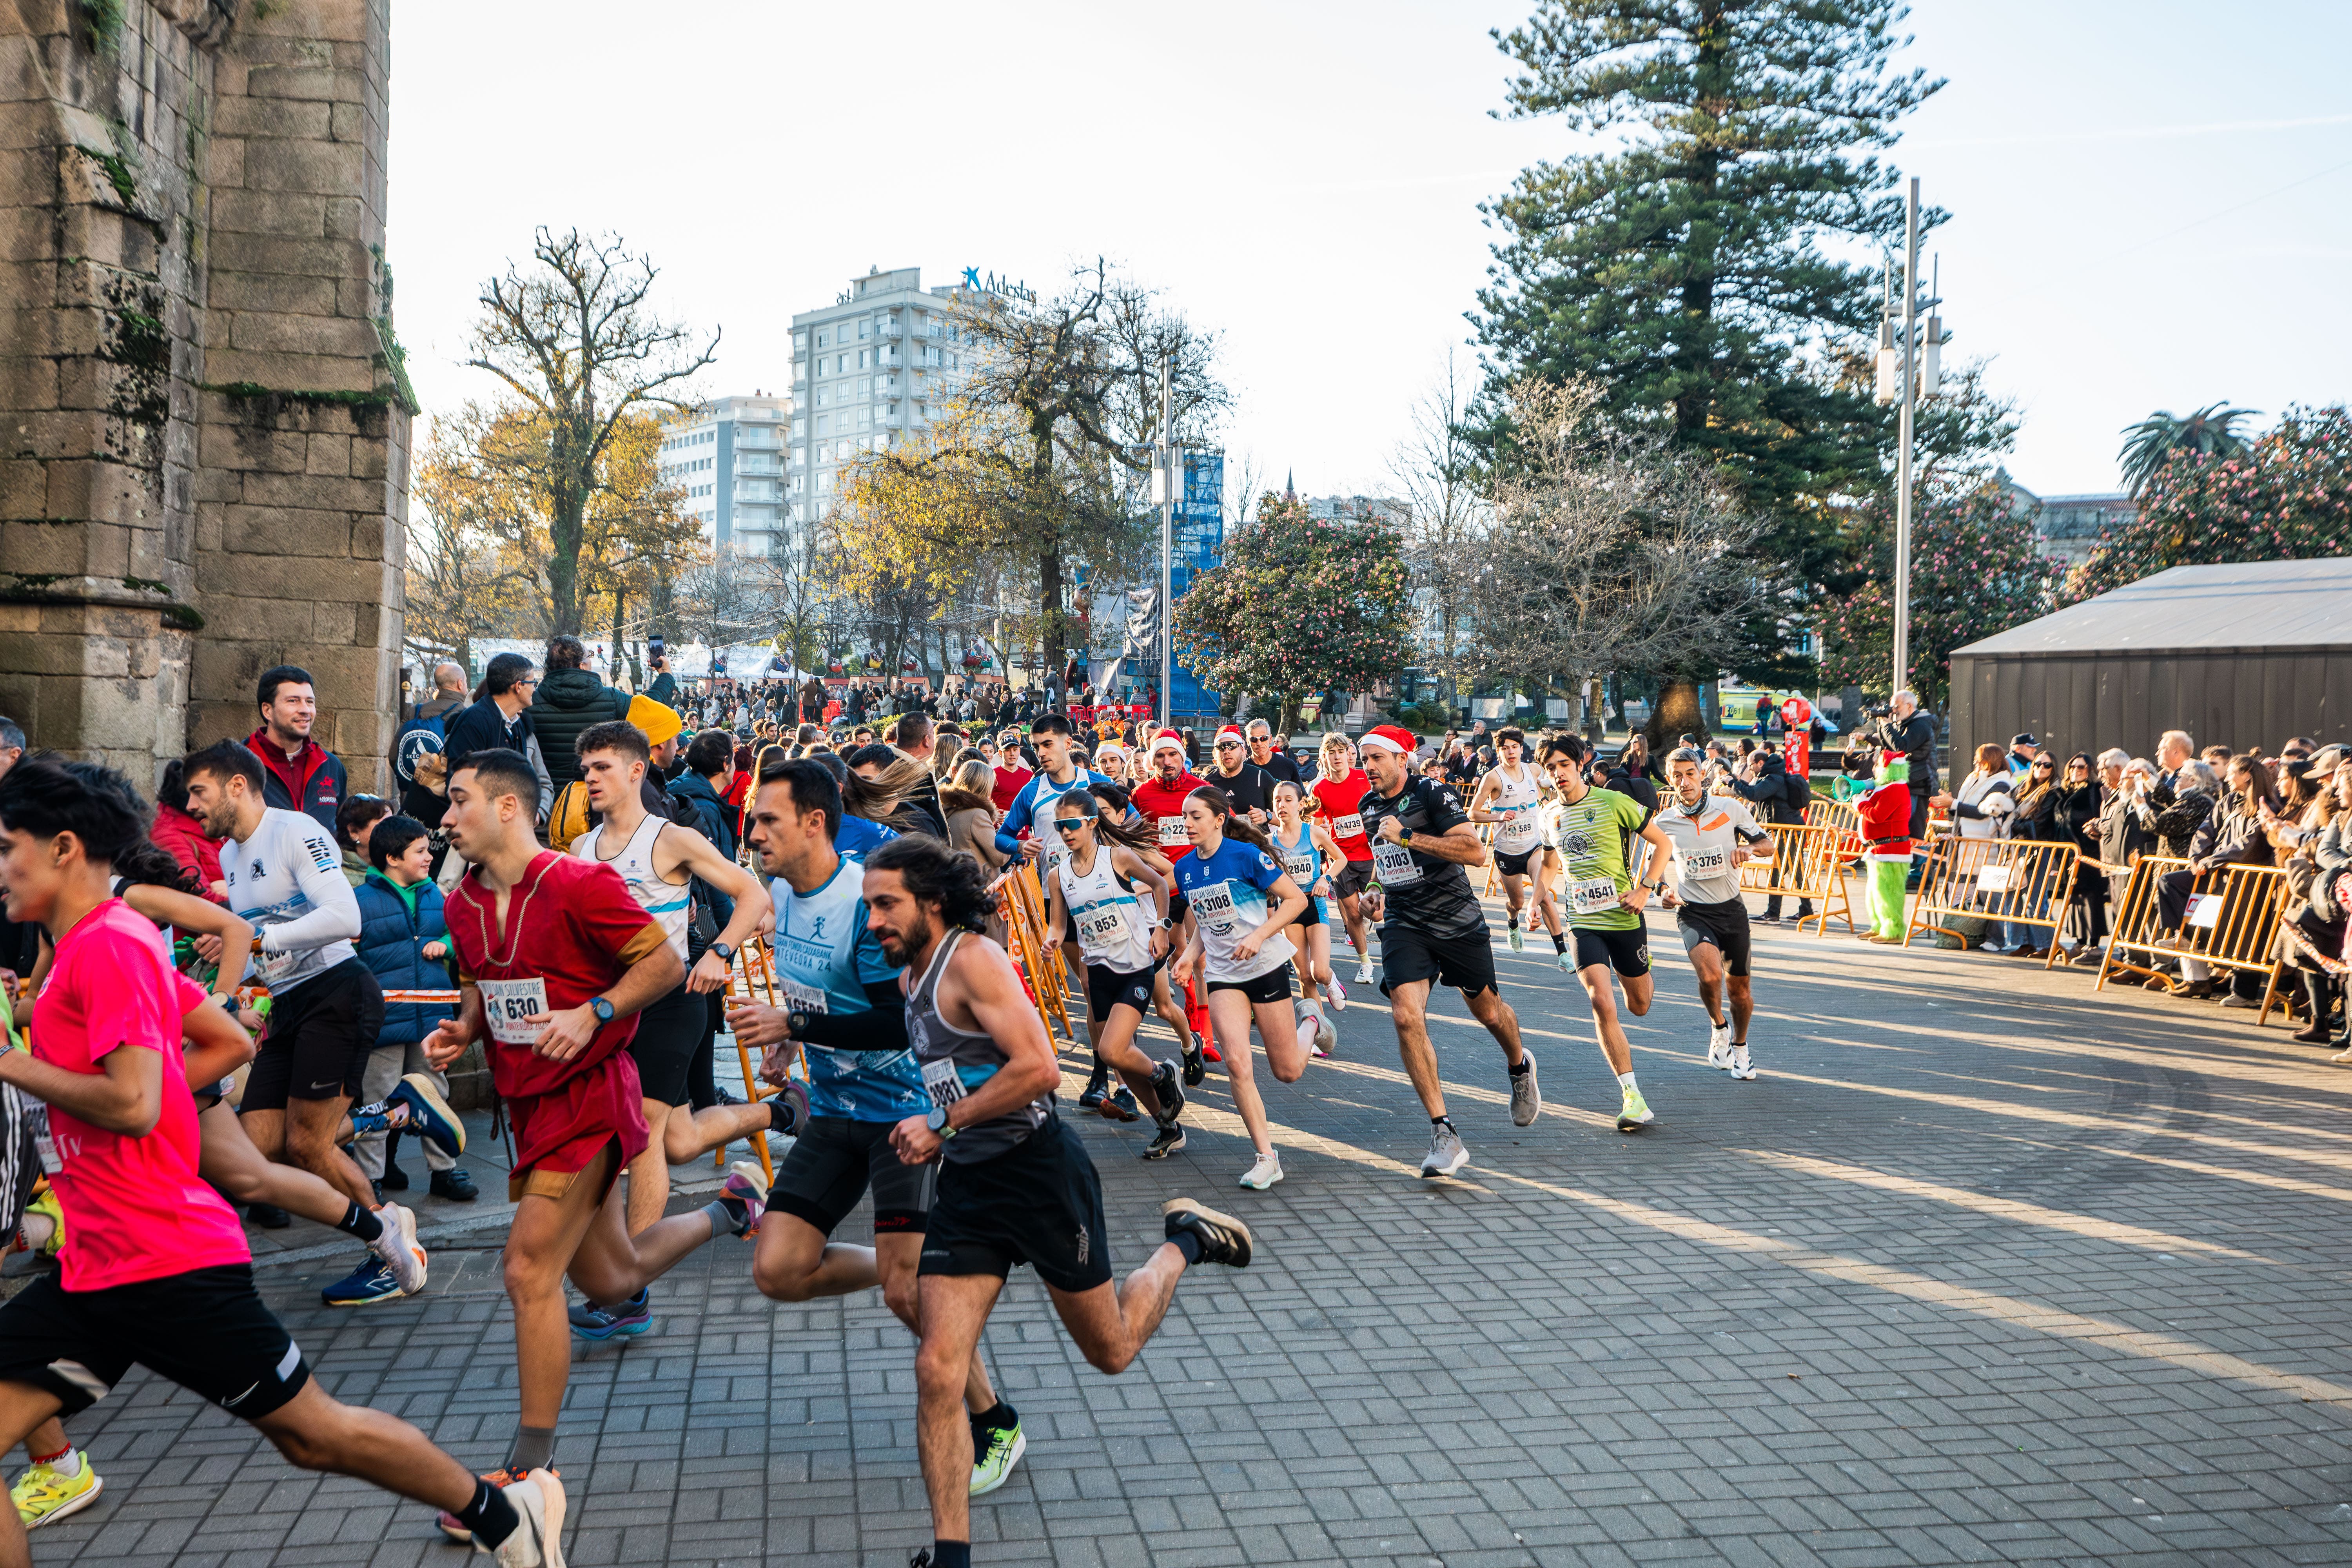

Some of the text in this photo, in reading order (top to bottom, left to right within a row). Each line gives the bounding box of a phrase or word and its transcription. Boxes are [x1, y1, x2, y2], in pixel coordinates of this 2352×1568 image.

[1344, 820, 1361, 829] 4739
[1519, 823, 1531, 832] 589
[1386, 845, 1406, 854] SILVESTRE
[1702, 846, 1721, 856] SILVESTRE
[1385, 852, 1409, 868] 3103
[1699, 853, 1722, 867] 3785
[1289, 863, 1311, 874] 2840
[1387, 867, 1405, 876] PONTEVEDRA
[1590, 877, 1612, 887] SILVESTRE
[1197, 890, 1205, 899] SAN
[1206, 884, 1227, 897] SILVESTRE
[1589, 885, 1613, 899] 4541
[1204, 894, 1230, 911] 3108
[1083, 913, 1093, 922] SAN
[1093, 904, 1117, 919] SILVESTRE
[1208, 910, 1226, 919] PONTEVEDRA
[1094, 915, 1118, 932] 853
[1096, 929, 1116, 941] PONTEVEDRA
[803, 944, 833, 960] CAIXABANK
[818, 960, 831, 972] 24
[492, 982, 505, 996] SAN
[505, 982, 543, 996] SILVESTRE
[505, 997, 539, 1020] 630
[929, 1076, 962, 1107] 3881
